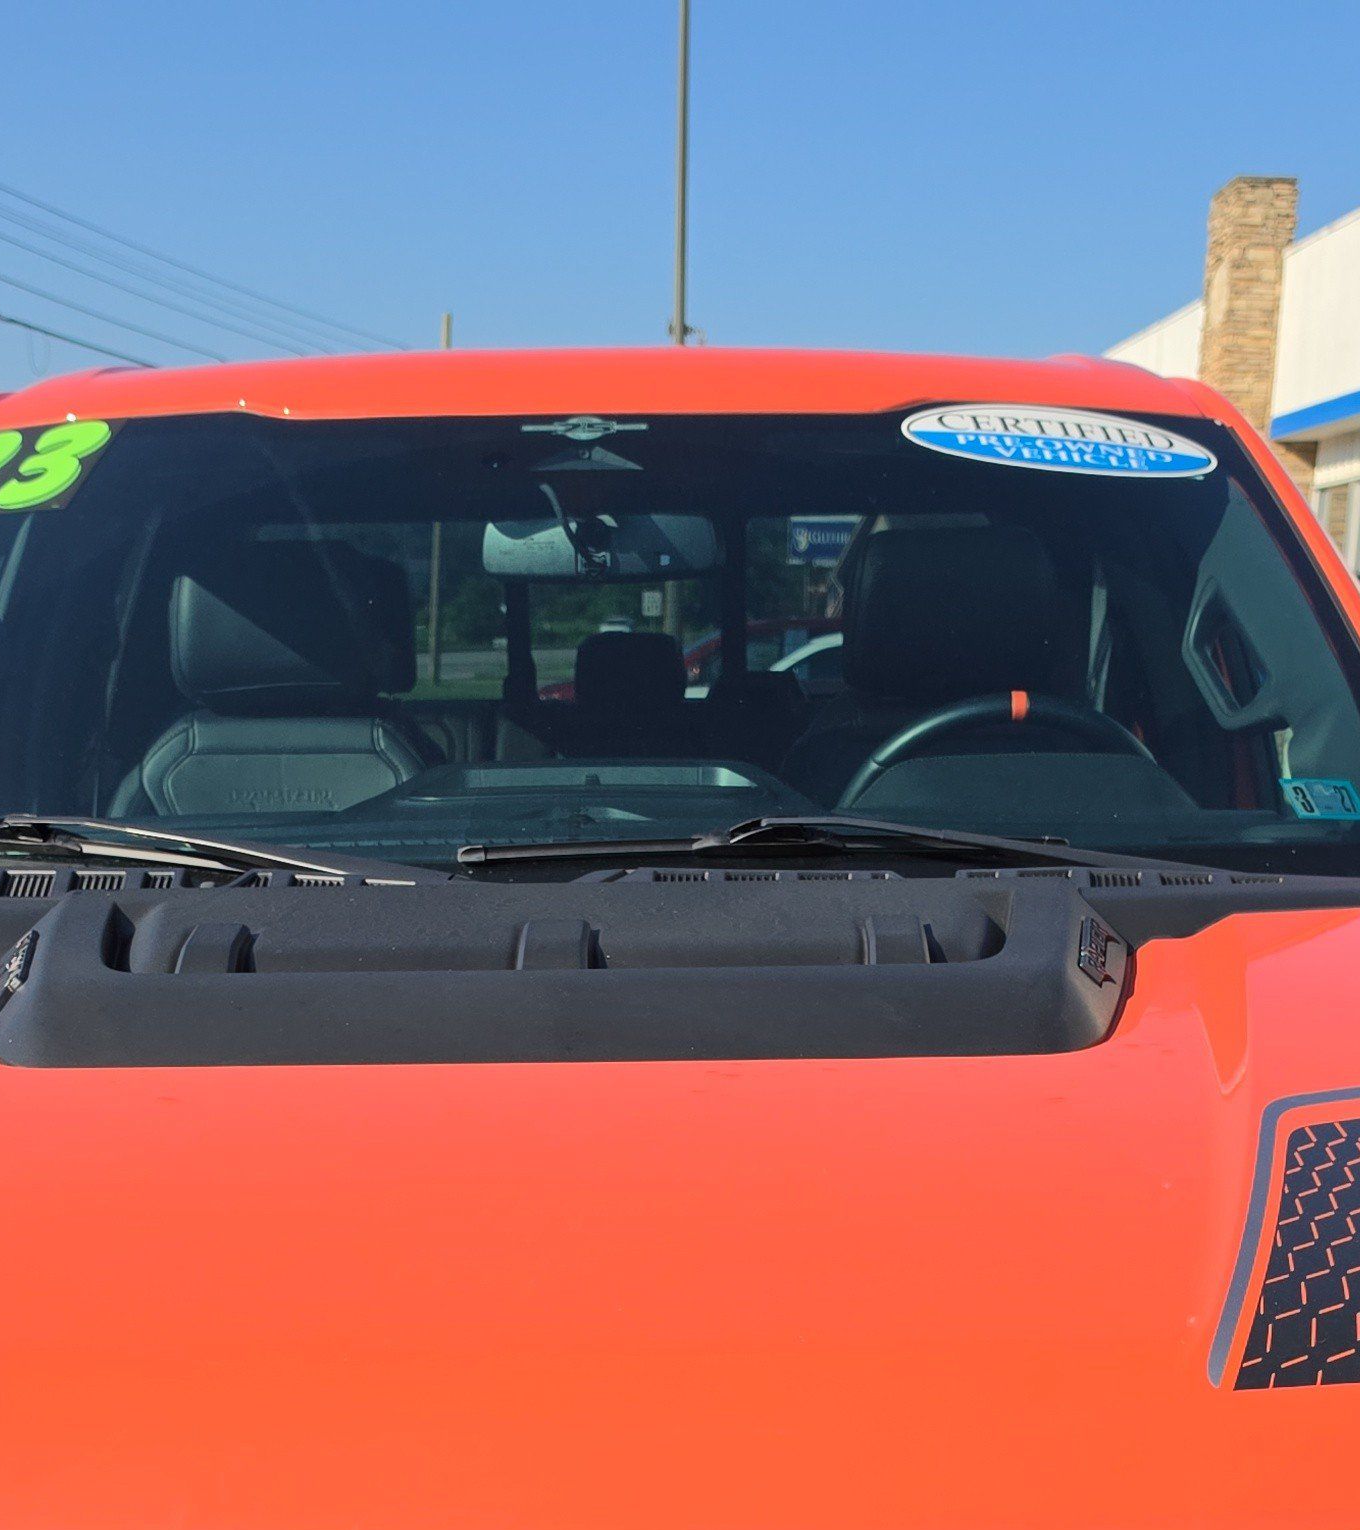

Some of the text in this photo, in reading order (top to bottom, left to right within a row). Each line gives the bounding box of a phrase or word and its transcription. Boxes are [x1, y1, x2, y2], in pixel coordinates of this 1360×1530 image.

[936, 404, 1174, 449] CERTIFIED
[955, 432, 1173, 464] PRE-OWNED
[993, 446, 1149, 471] VEHICLE
[1291, 785, 1315, 813] 3
